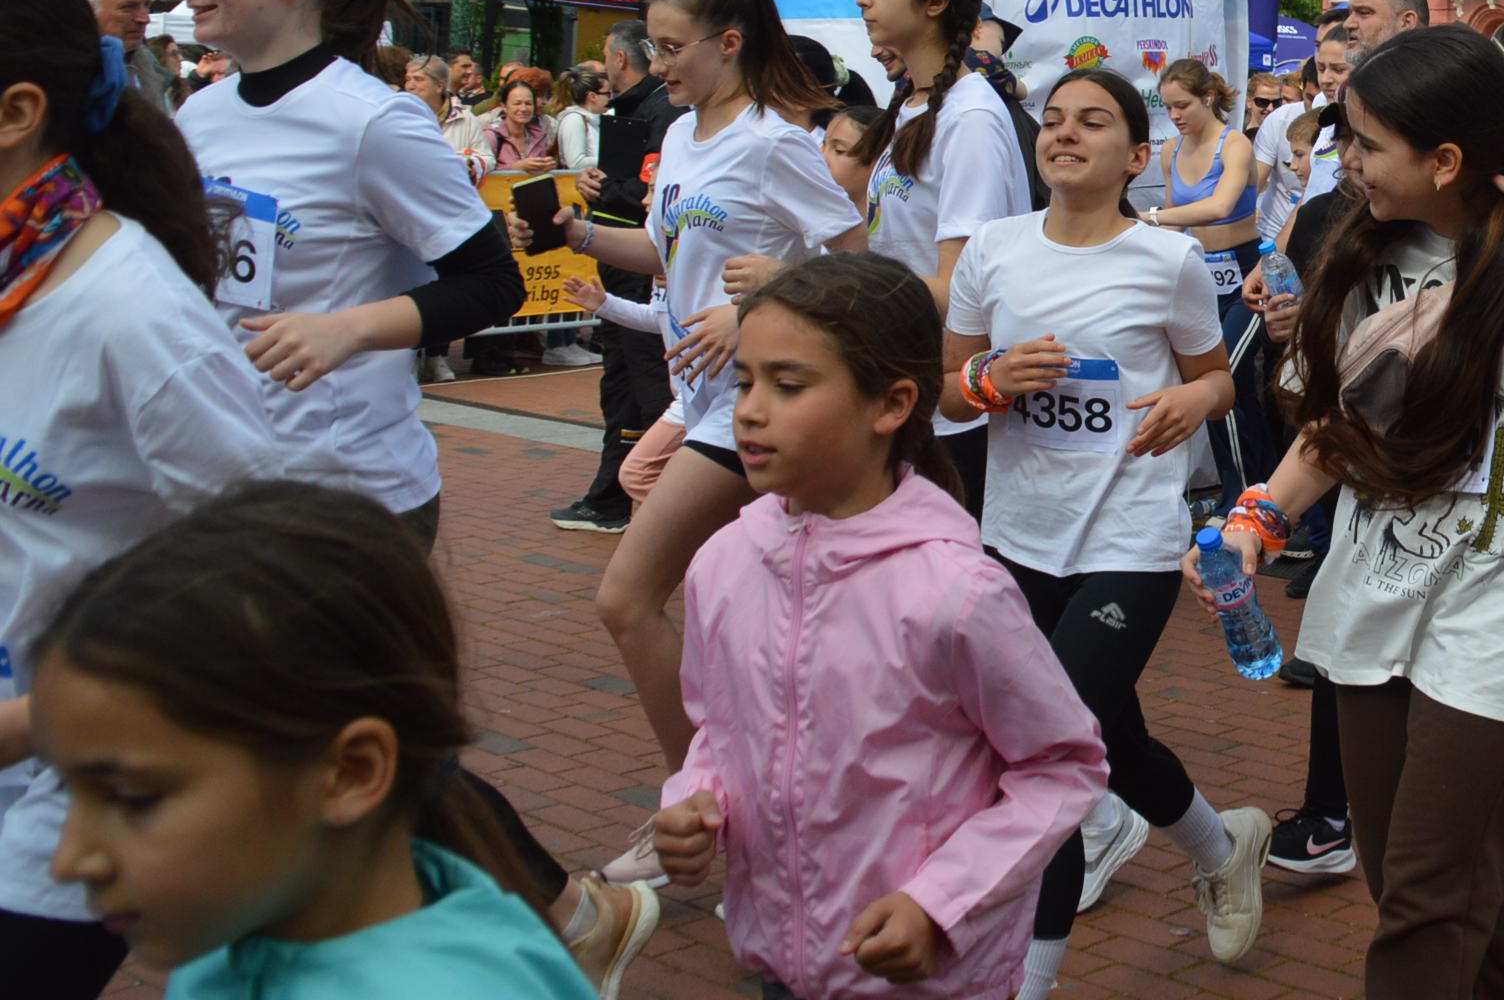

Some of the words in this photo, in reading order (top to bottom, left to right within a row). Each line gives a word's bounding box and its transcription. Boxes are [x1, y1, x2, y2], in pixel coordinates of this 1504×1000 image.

[666, 193, 728, 229] Marathon
[526, 264, 561, 281] 9595
[1210, 268, 1238, 287] 92
[1013, 390, 1113, 433] 4358
[0, 437, 72, 504] thon
[1377, 579, 1399, 595] THE
[1400, 587, 1427, 600] SUN
